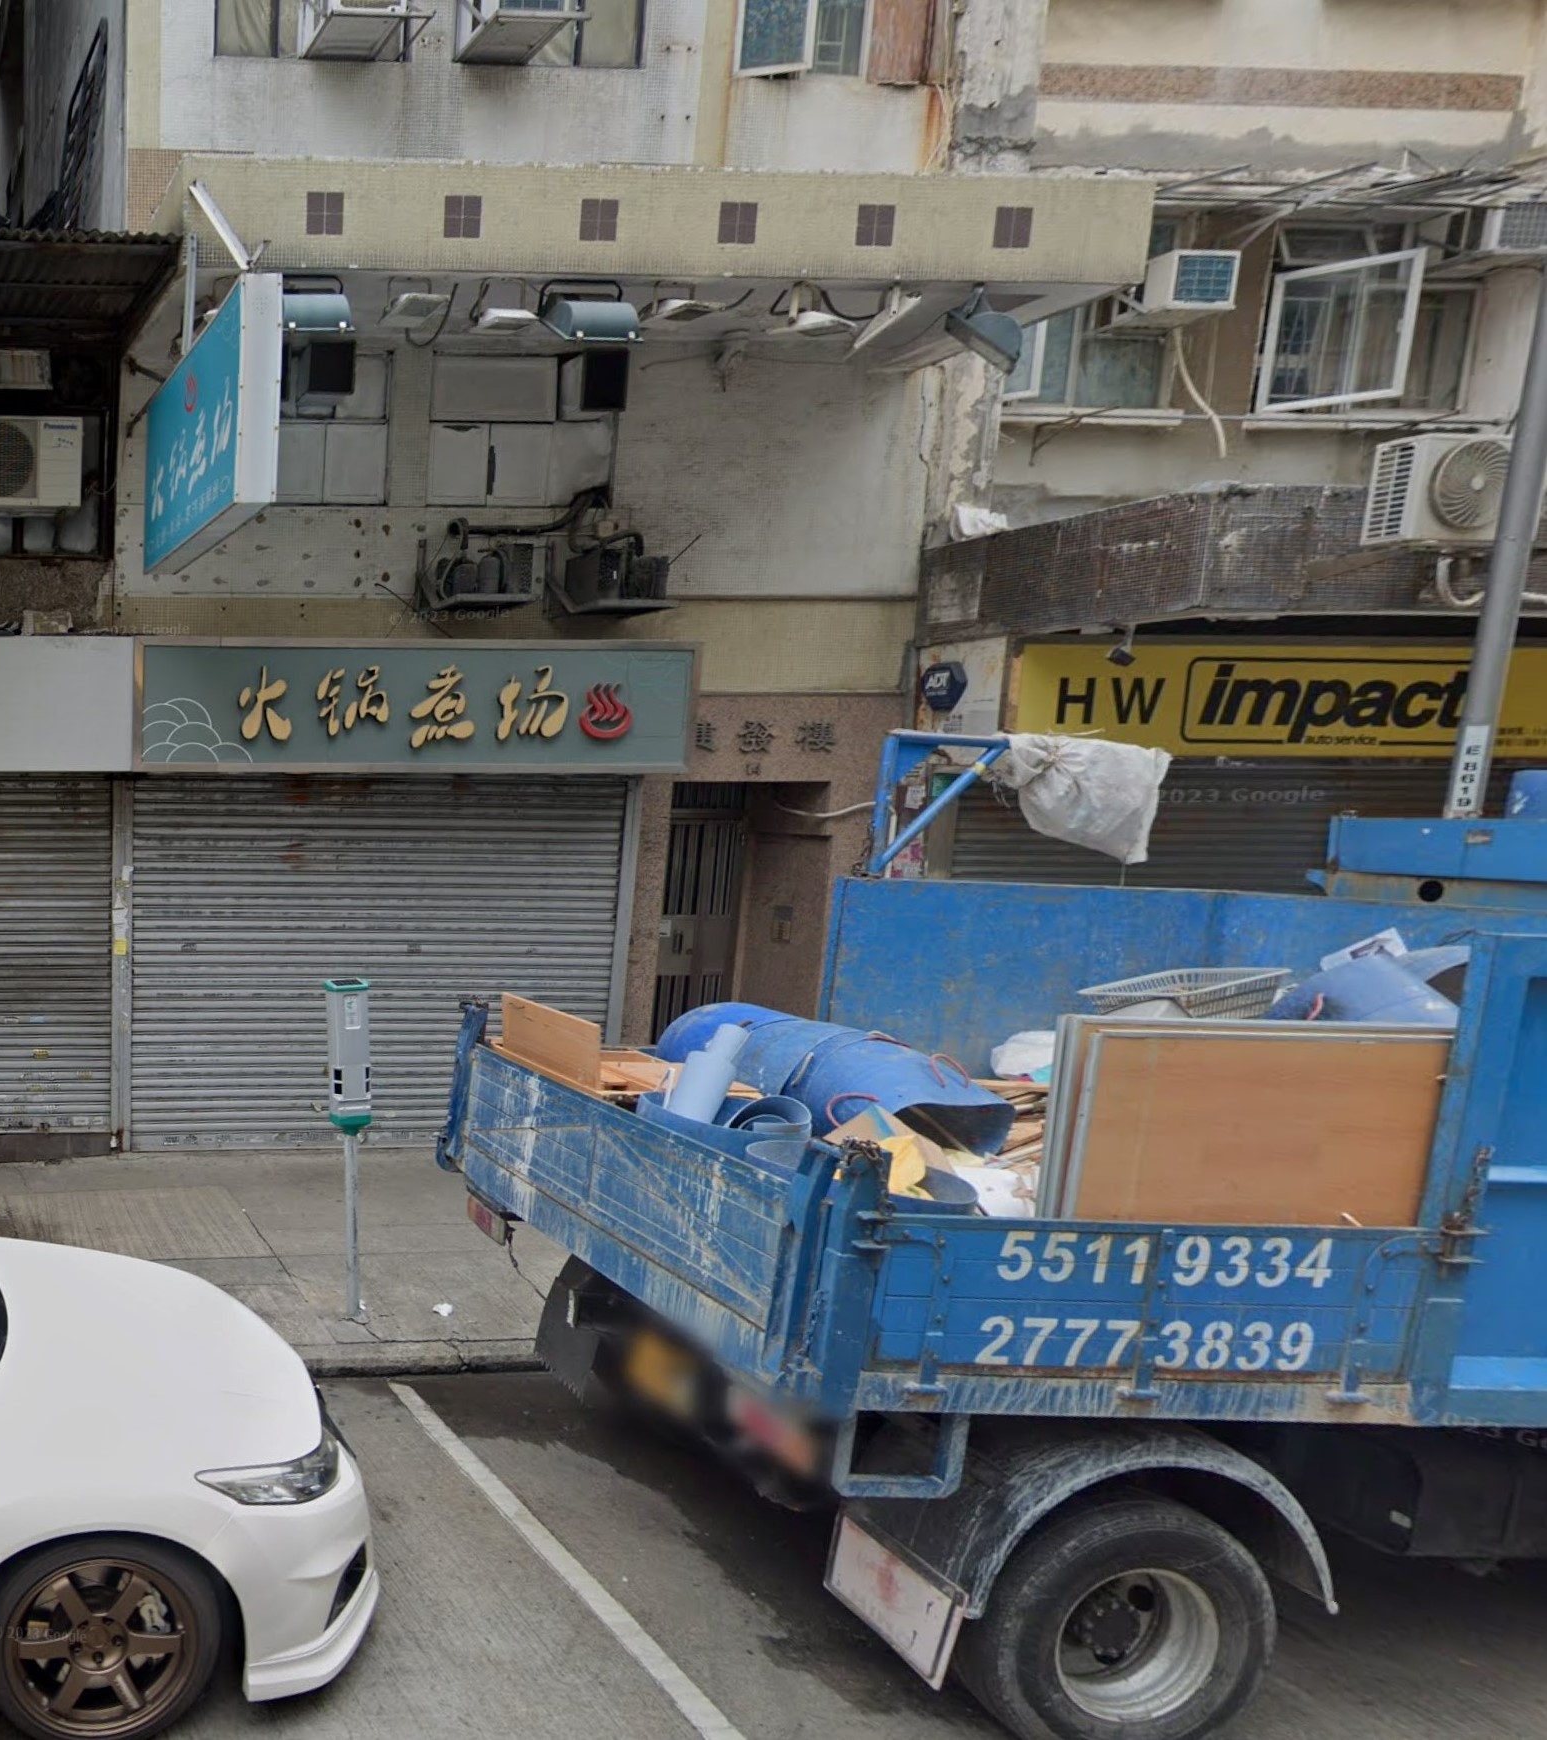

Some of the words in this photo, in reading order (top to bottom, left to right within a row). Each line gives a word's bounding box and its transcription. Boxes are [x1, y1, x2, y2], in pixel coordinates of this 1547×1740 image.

[925, 671, 951, 690] ADT
[1198, 663, 1471, 743] impact
[996, 1230, 1151, 1285] 5511
[1172, 1235, 1333, 1289] 9334
[974, 1315, 1141, 1367] 2777
[1154, 1320, 1314, 1372] 3839
